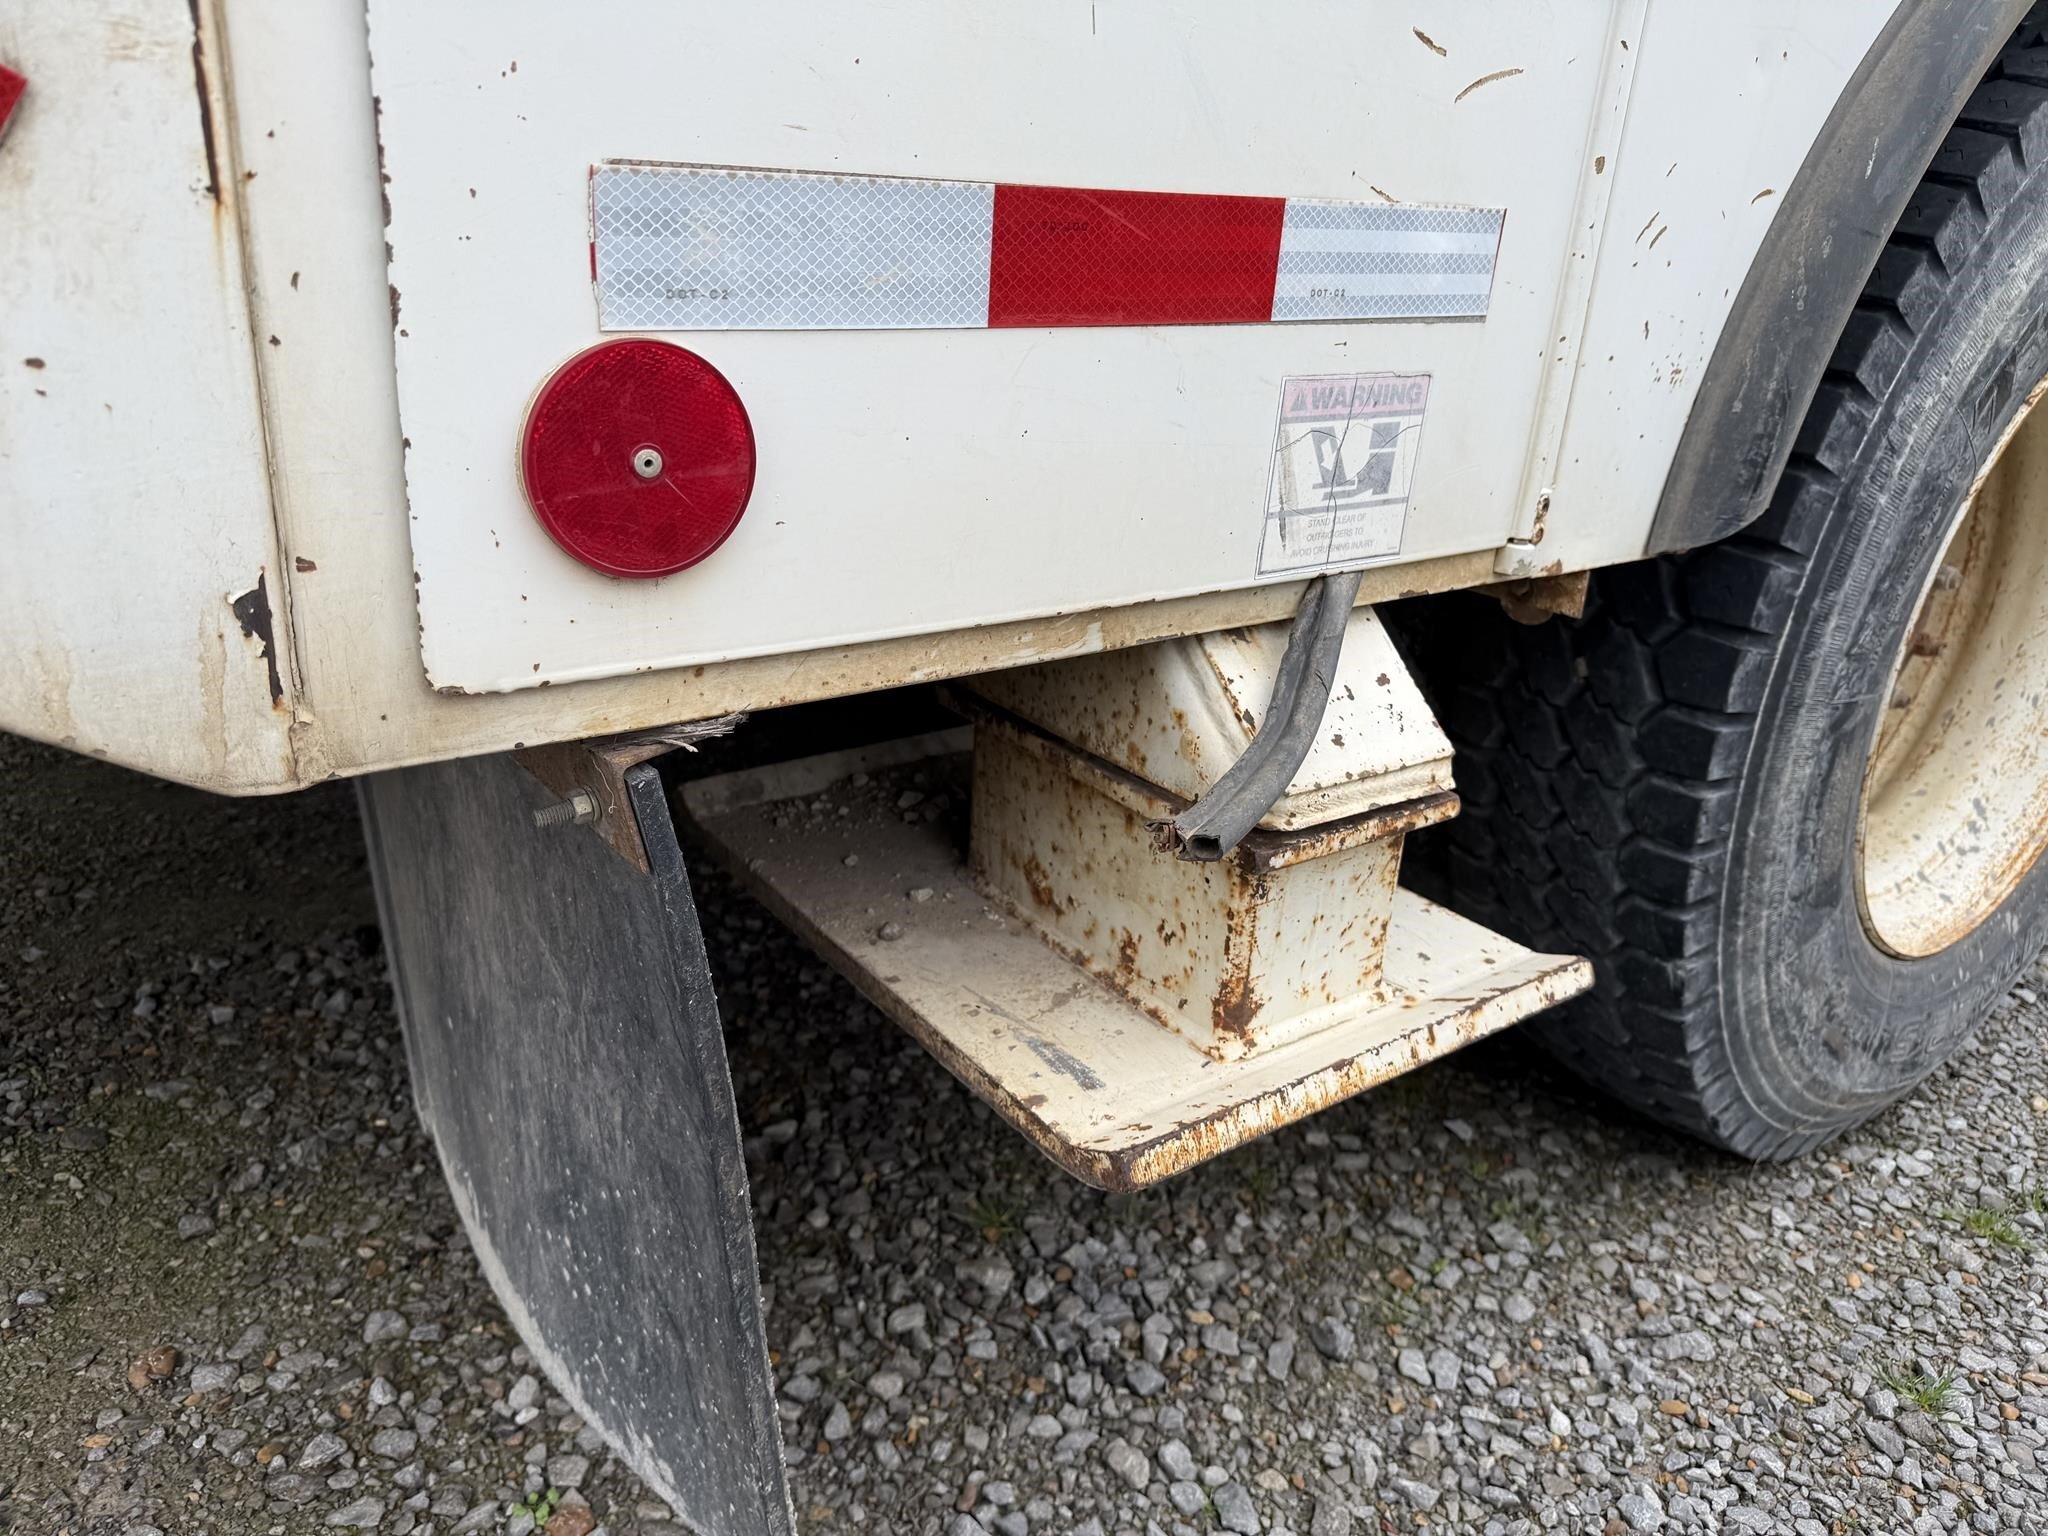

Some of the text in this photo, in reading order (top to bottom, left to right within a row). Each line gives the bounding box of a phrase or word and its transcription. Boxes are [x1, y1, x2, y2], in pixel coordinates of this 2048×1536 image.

[665, 289, 728, 299] DOT-C2
[1310, 288, 1345, 299] DOT-C2
[1311, 382, 1423, 410] WARNING
[1308, 518, 1331, 528] STAND
[1355, 527, 1364, 535] TO
